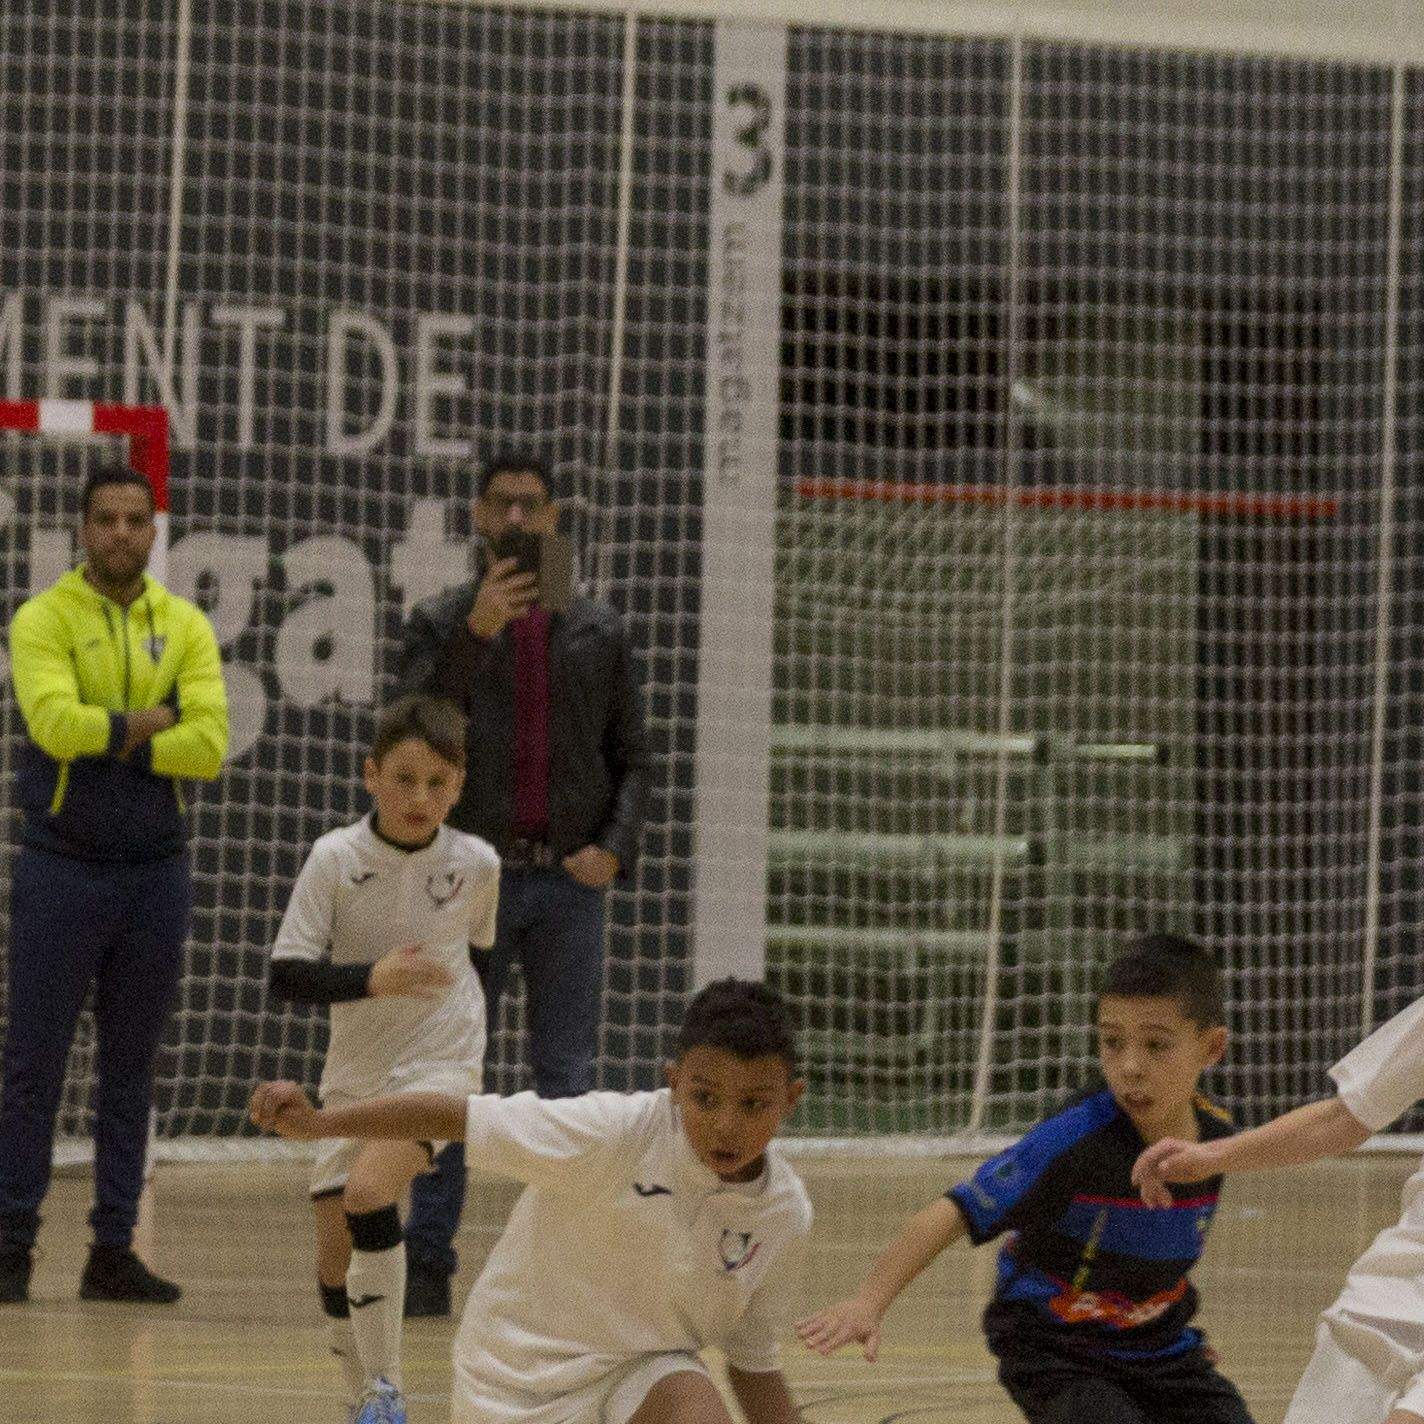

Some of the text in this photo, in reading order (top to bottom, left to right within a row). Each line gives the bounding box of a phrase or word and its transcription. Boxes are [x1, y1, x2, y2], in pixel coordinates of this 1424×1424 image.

[722, 81, 773, 197] 3
[327, 309, 475, 457] DE
[715, 220, 753, 486] magatzem
